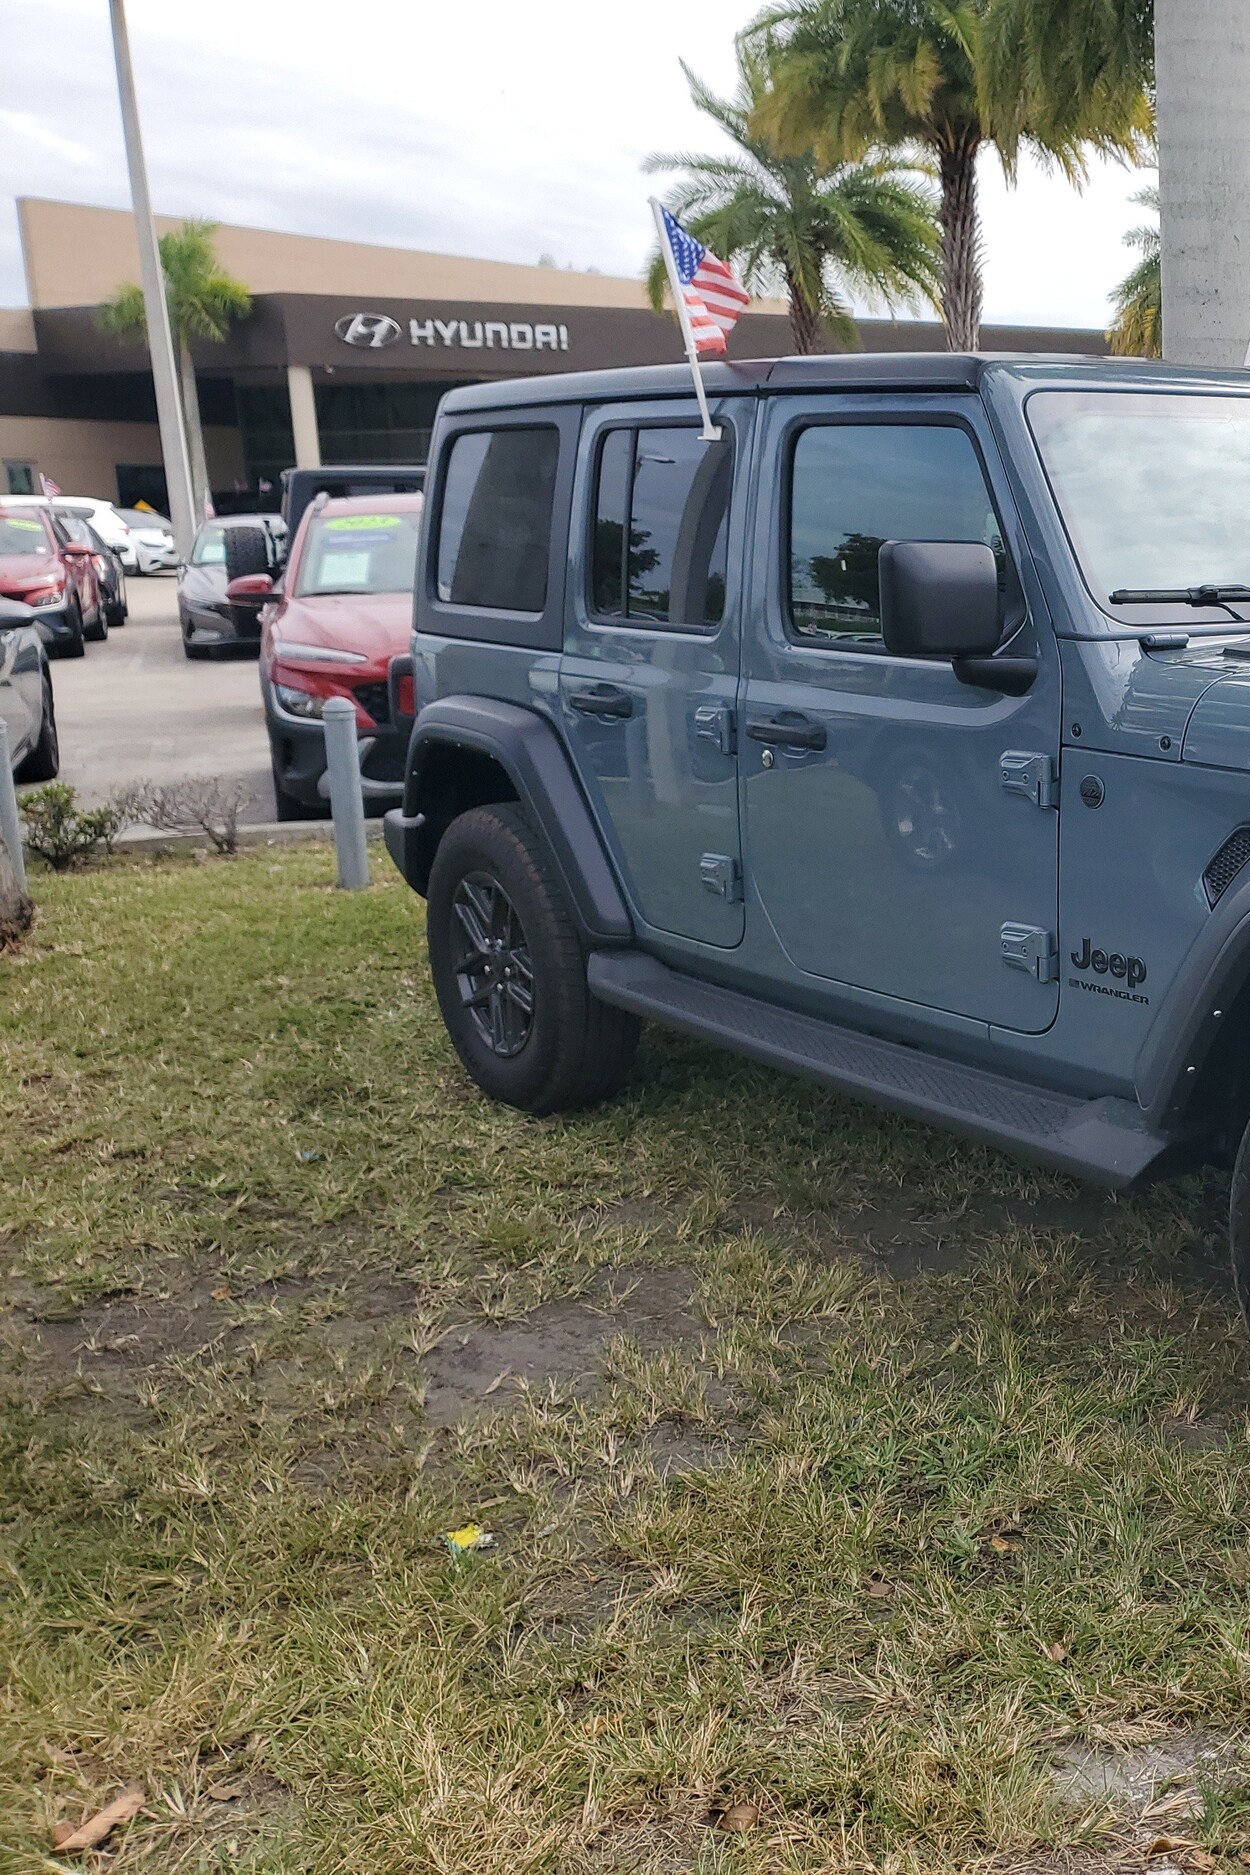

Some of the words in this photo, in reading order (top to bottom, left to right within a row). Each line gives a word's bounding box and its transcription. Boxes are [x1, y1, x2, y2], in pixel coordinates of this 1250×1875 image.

[409, 318, 569, 350] HYUNDAI
[1070, 937, 1147, 988] Jeep
[1080, 981, 1150, 1006] WRANGLER
